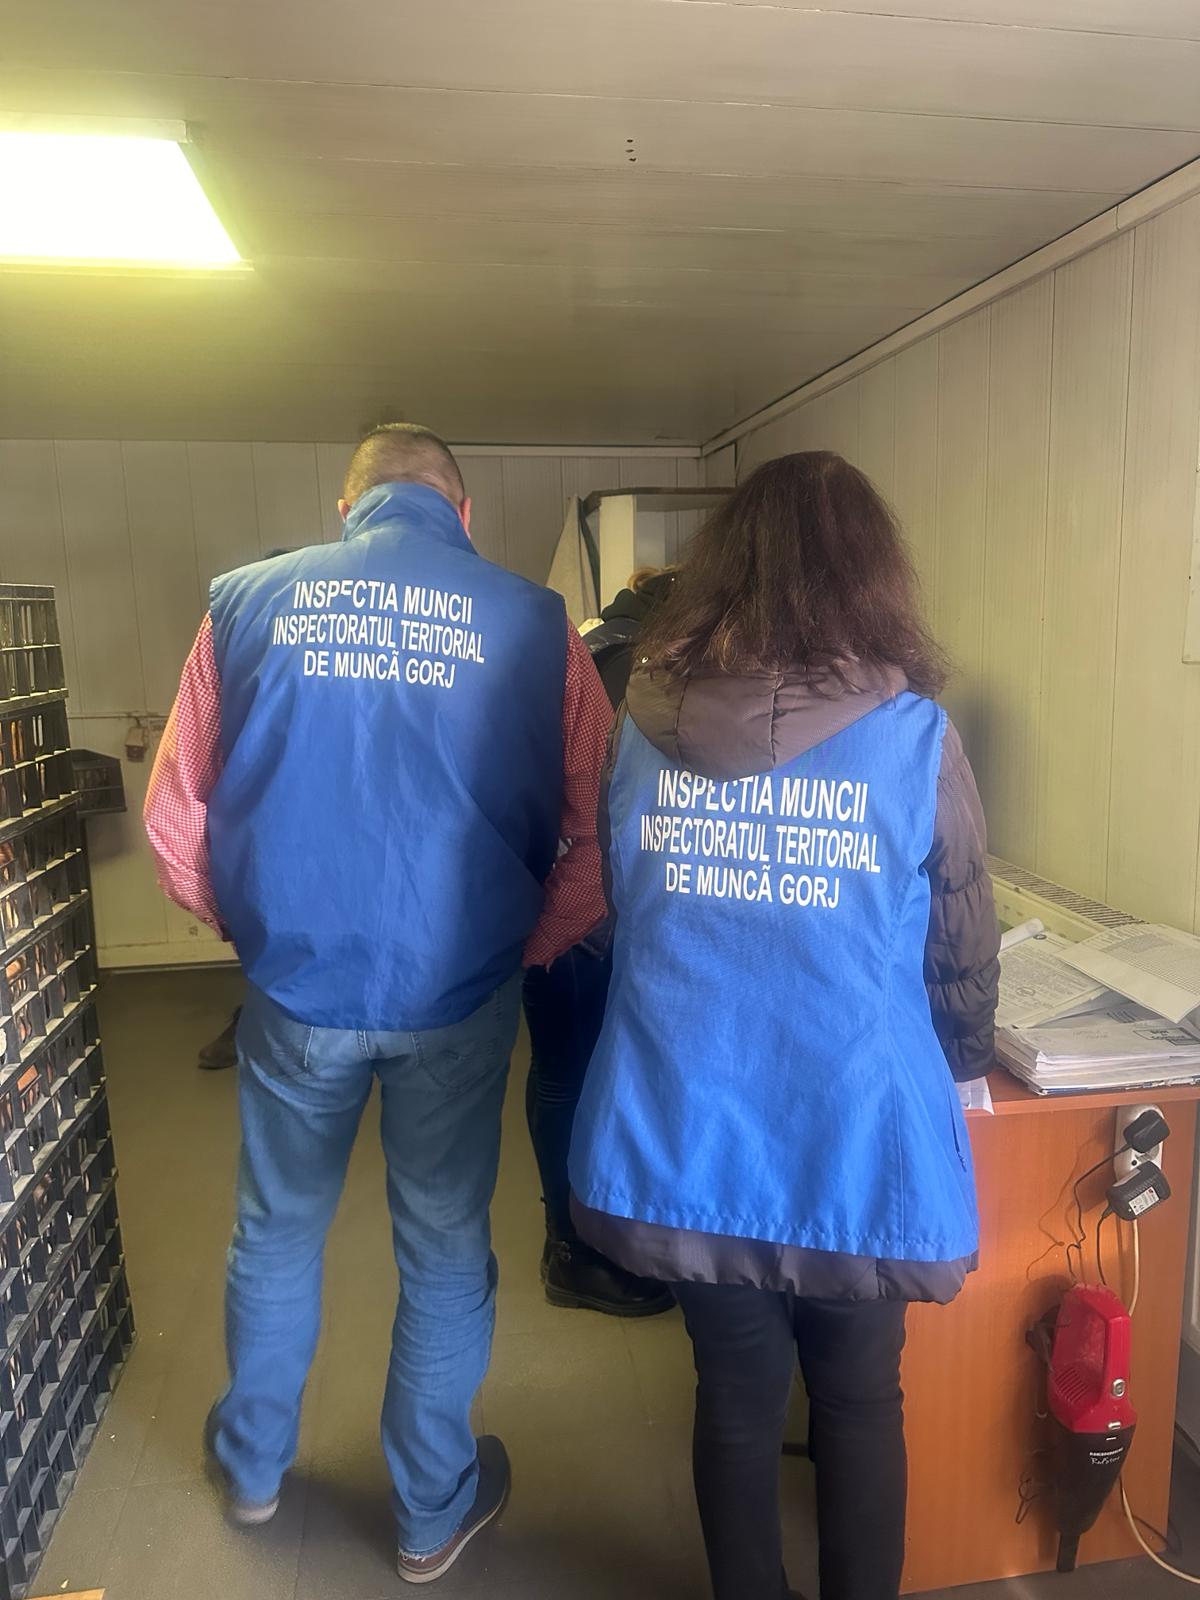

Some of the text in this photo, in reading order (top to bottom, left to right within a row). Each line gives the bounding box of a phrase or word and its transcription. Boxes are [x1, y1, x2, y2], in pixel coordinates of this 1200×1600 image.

[292, 579, 473, 625] INSPECTIA MUNCII
[272, 613, 486, 664] INSPECTORATUL TERITORIAL
[303, 650, 330, 677] DE
[405, 657, 456, 689] GORJ
[779, 777, 869, 824] MUNCII
[640, 814, 882, 874] INSPECTORATUL TERITORIAL
[665, 862, 692, 894] DE
[778, 873, 840, 909] GORJ
